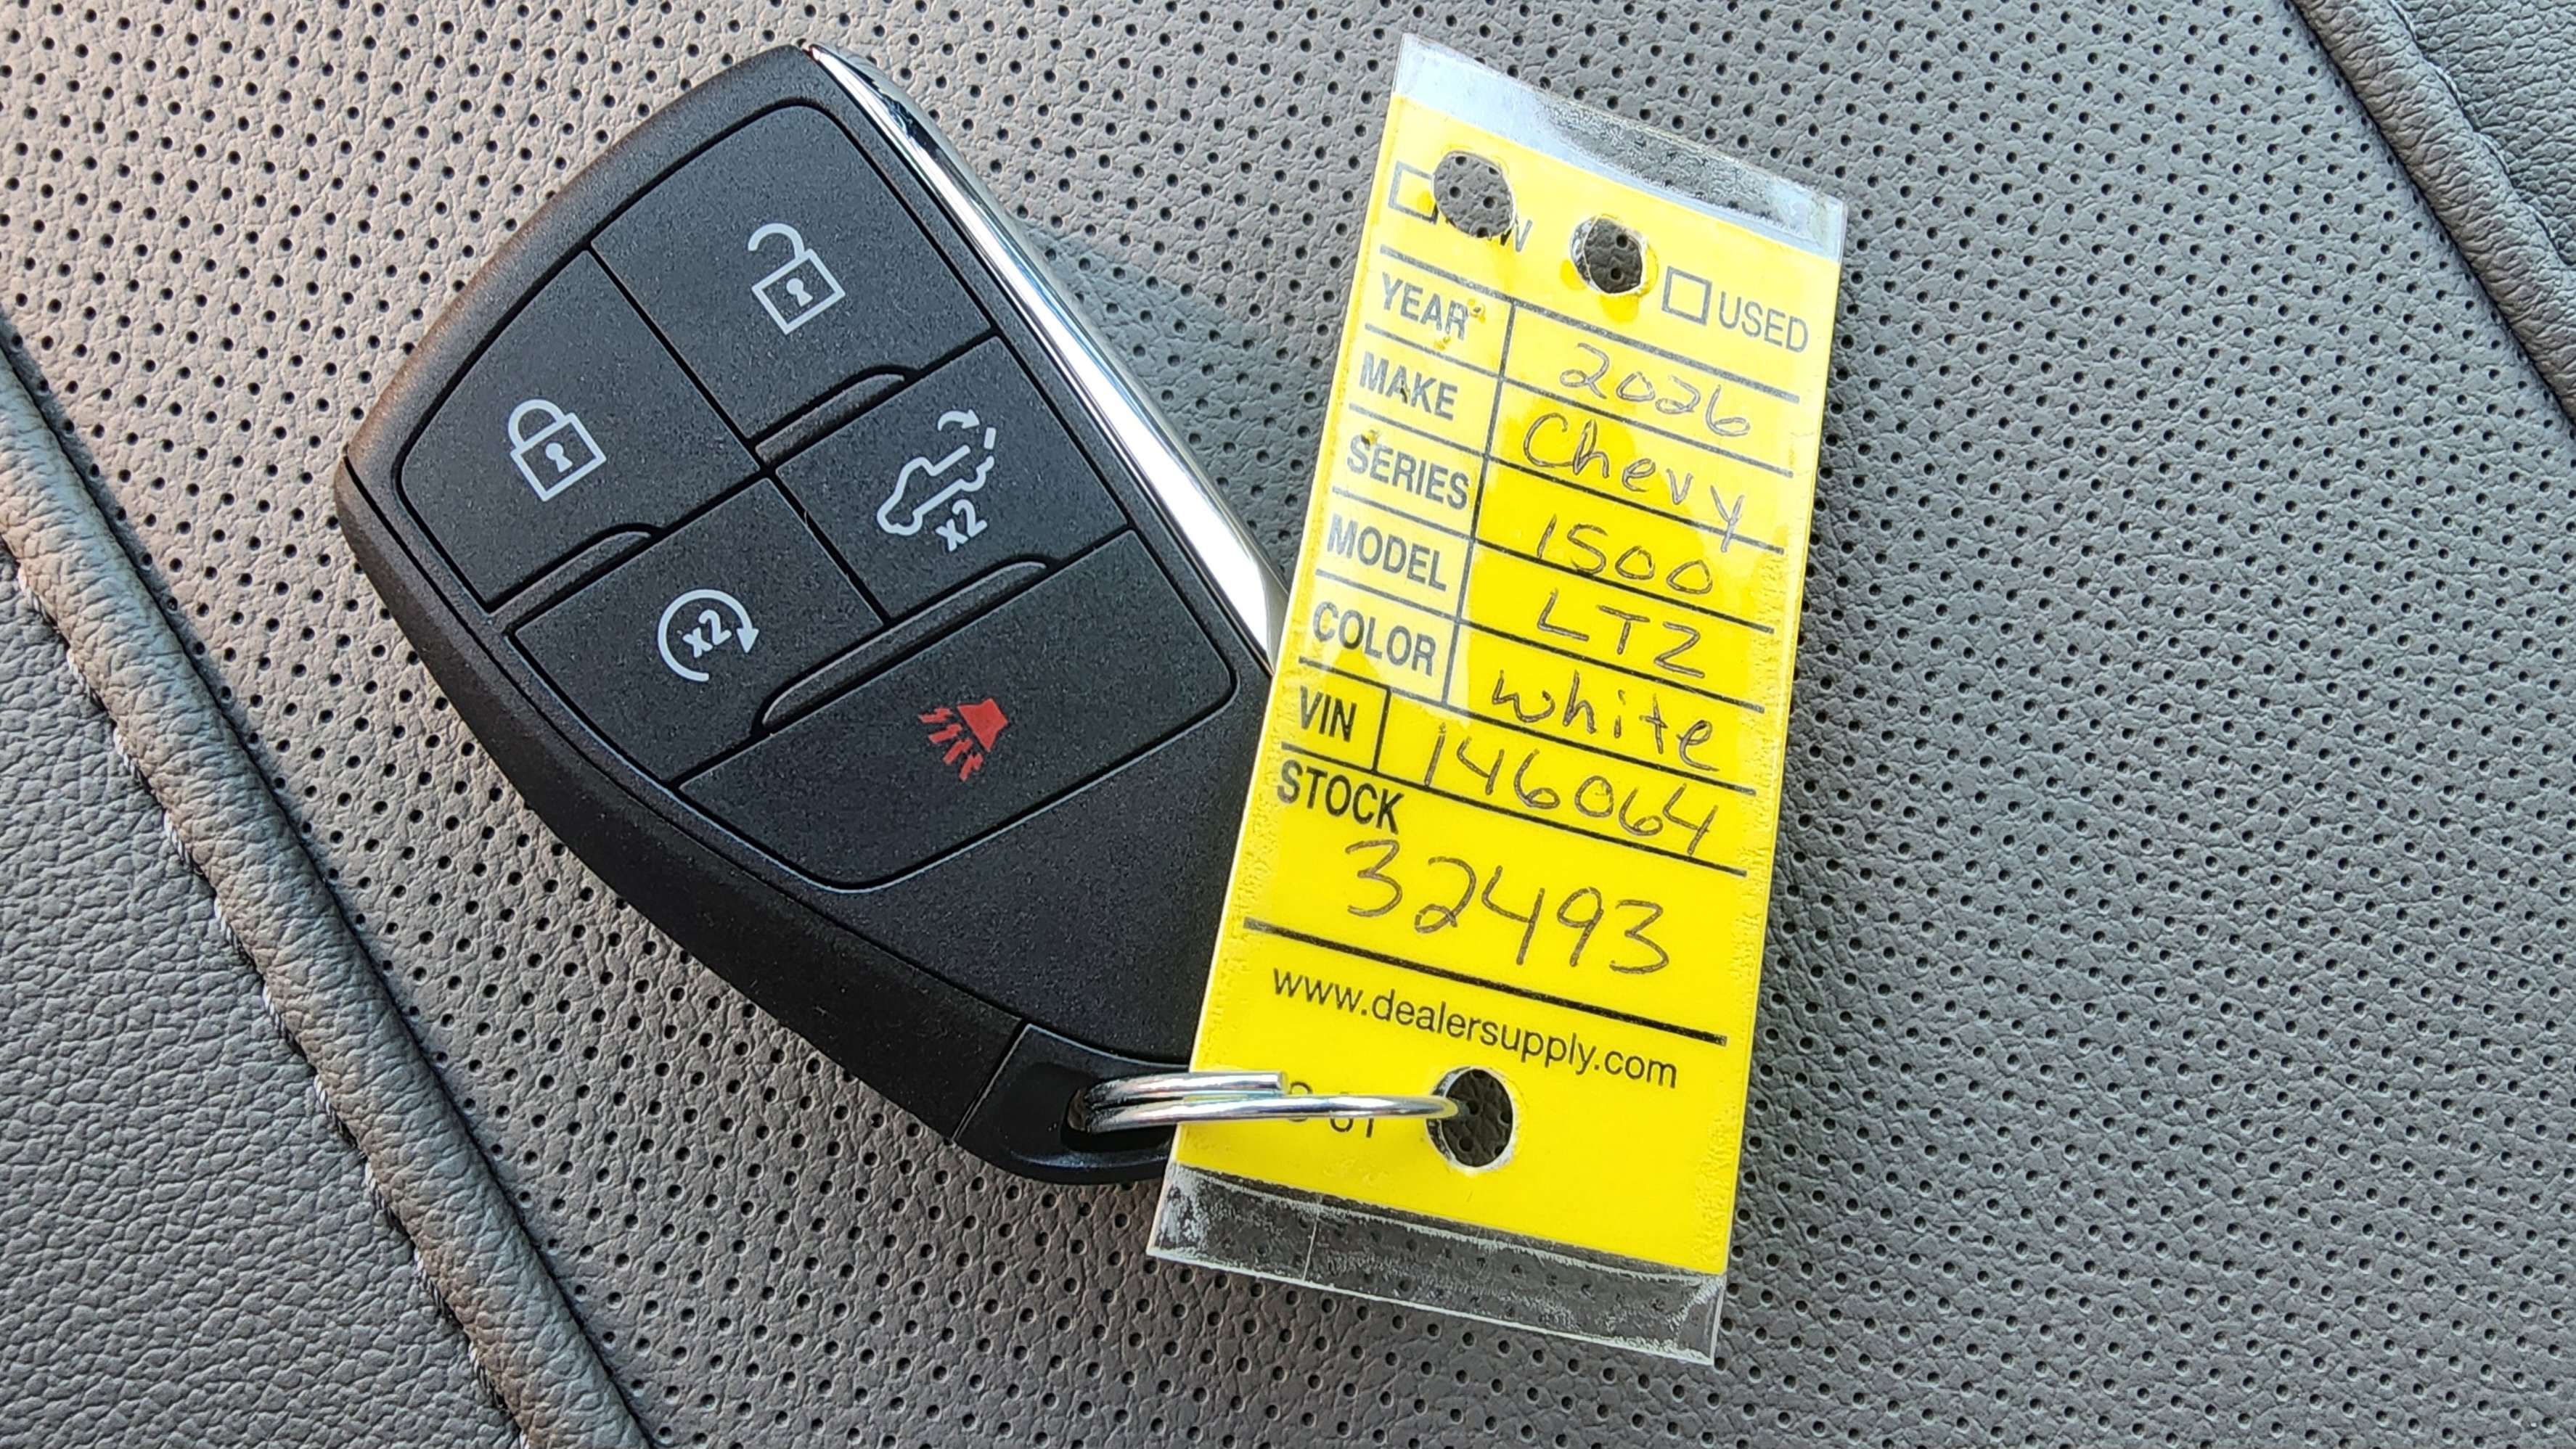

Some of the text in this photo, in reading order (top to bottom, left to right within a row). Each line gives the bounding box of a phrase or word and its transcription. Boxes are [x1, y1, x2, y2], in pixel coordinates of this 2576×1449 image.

[1382, 271, 1469, 340] YEAR
[1719, 291, 1808, 353] USED
[1359, 350, 1458, 422] MAKE
[1559, 342, 1751, 437] 2026
[1346, 433, 1470, 510] SERIES
[1523, 412, 1744, 554] Chevy
[935, 498, 988, 552] x2
[1326, 514, 1447, 592] MODEL
[1536, 514, 1714, 595] 1500
[682, 608, 732, 658] x2
[1312, 600, 1437, 677] COLOR
[1299, 685, 1358, 742] VIN
[1276, 758, 1406, 834] STOCK
[1423, 722, 1719, 856] 146064
[1344, 838, 1671, 976] 32493
[1272, 966, 1678, 1089] www.dealersupply.com
